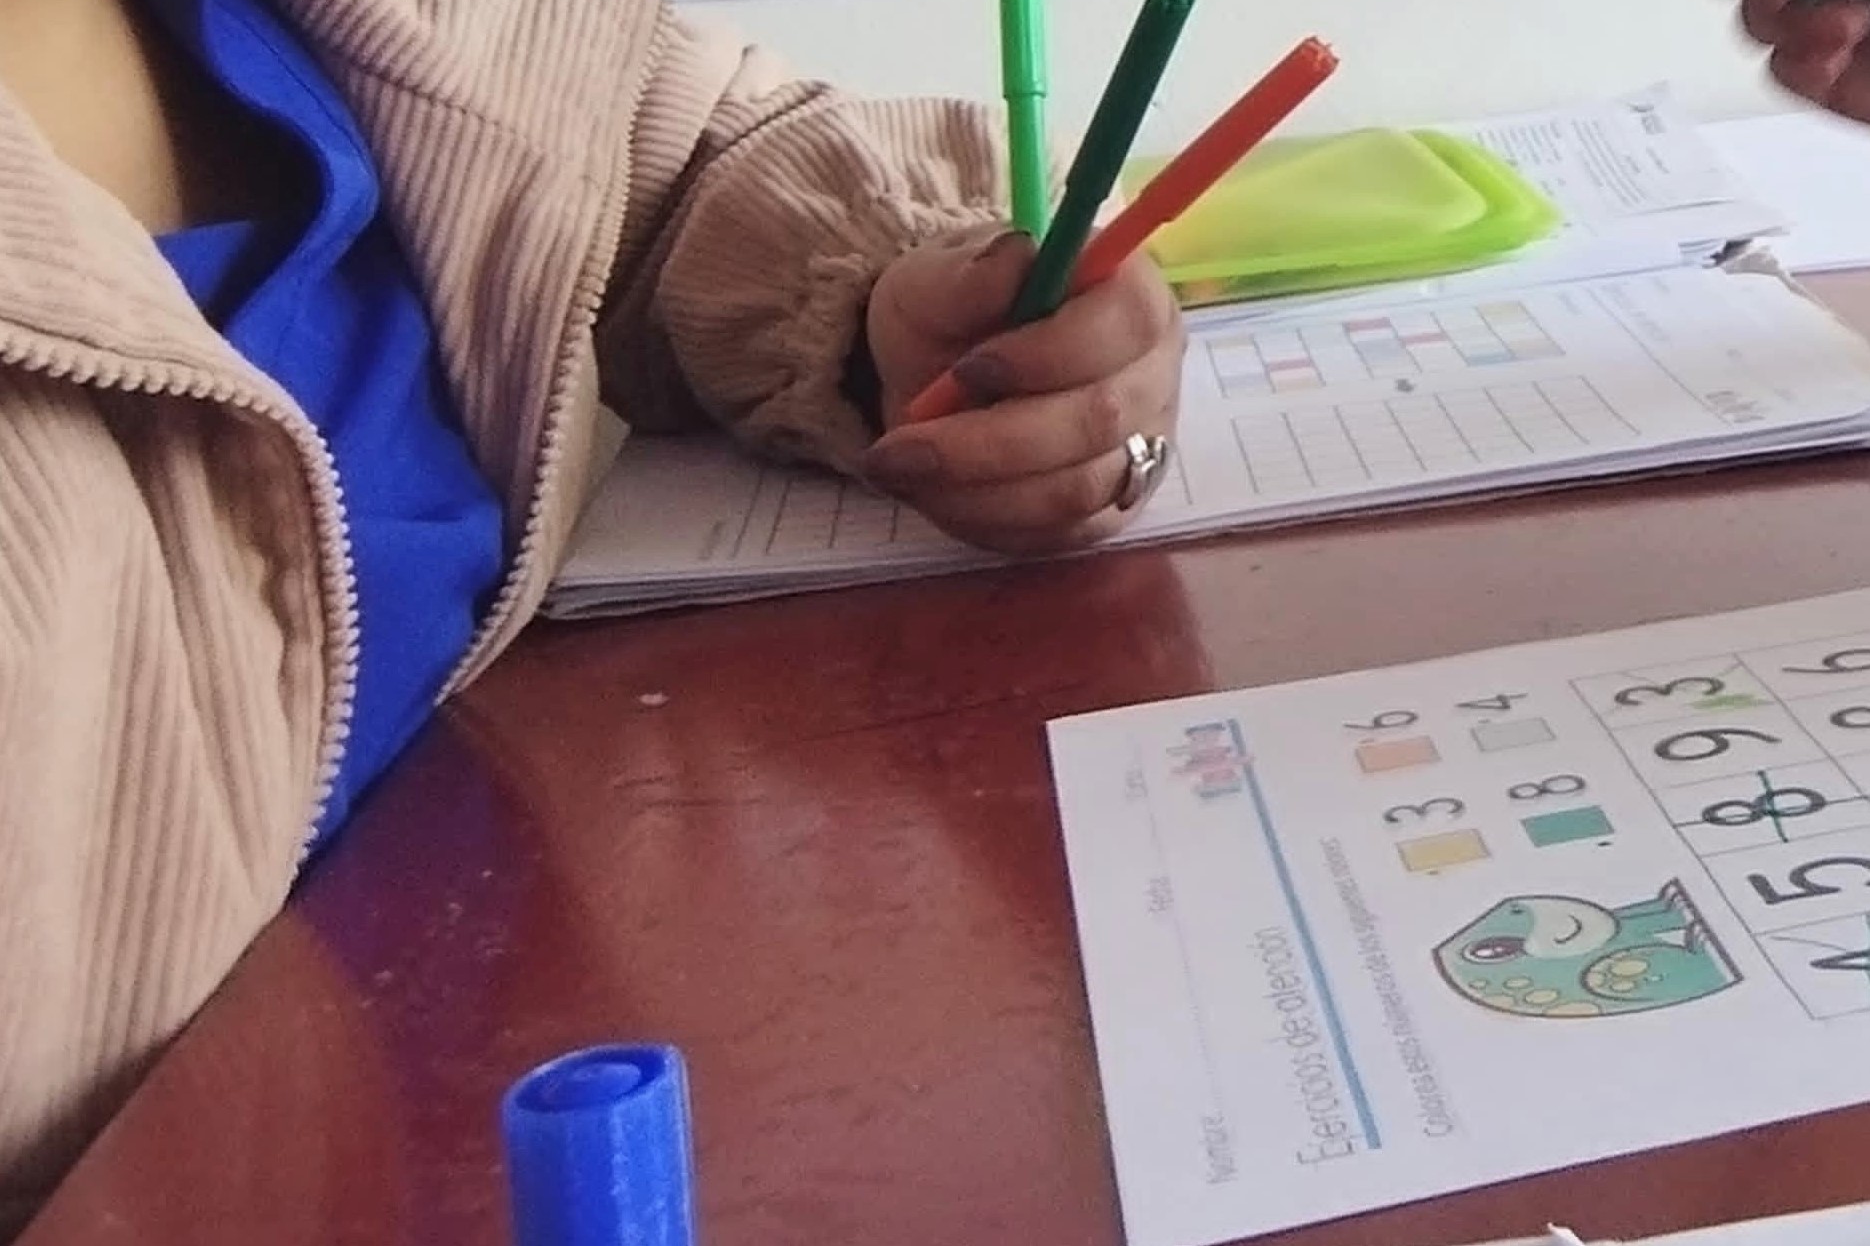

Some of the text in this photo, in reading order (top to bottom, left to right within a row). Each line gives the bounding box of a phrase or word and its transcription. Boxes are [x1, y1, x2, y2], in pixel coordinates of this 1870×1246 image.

[1455, 692, 1530, 711] 4
[1613, 675, 1726, 707] 3
[1341, 709, 1419, 731] 6
[1652, 727, 1781, 763] 9
[1506, 774, 1587, 801] 8
[1383, 796, 1466, 824] 3
[1702, 786, 1828, 829] 8
